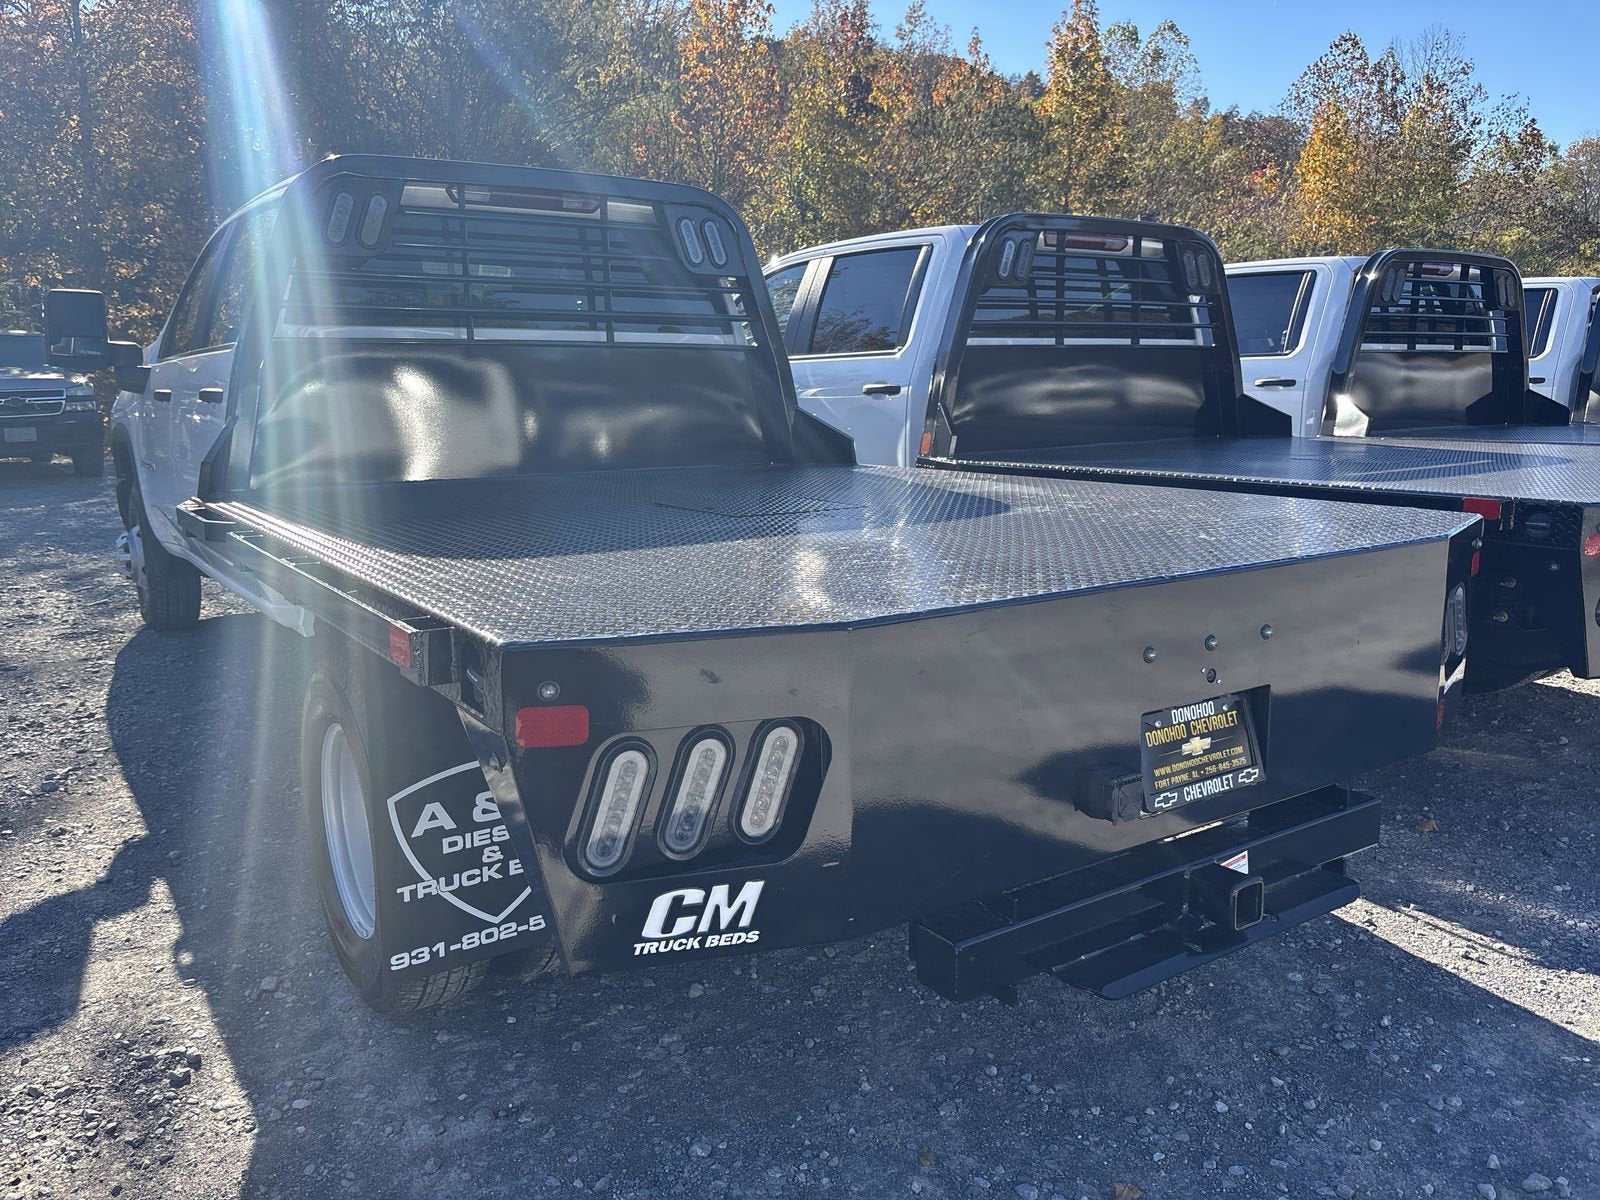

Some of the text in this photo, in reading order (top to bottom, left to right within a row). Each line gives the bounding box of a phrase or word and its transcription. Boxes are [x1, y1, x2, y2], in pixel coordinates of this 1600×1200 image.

[1145, 710, 1239, 748] DONOHOO CHEVROLET
[1171, 700, 1215, 725] DONOHOO
[1153, 745, 1245, 777] WWW.DONOHOOCHEVROLET.COM
[1154, 778, 1171, 790] FORT
[1191, 769, 1200, 779] AL
[1204, 756, 1247, 775] 256-845-3525
[1183, 773, 1236, 802] CHEVROLET
[410, 801, 458, 838] A
[482, 845, 504, 863] &
[396, 862, 503, 903] TRUCK
[641, 880, 766, 939] CM
[390, 914, 547, 971] 931-802-5
[633, 930, 761, 956] TRUCK BEDS
